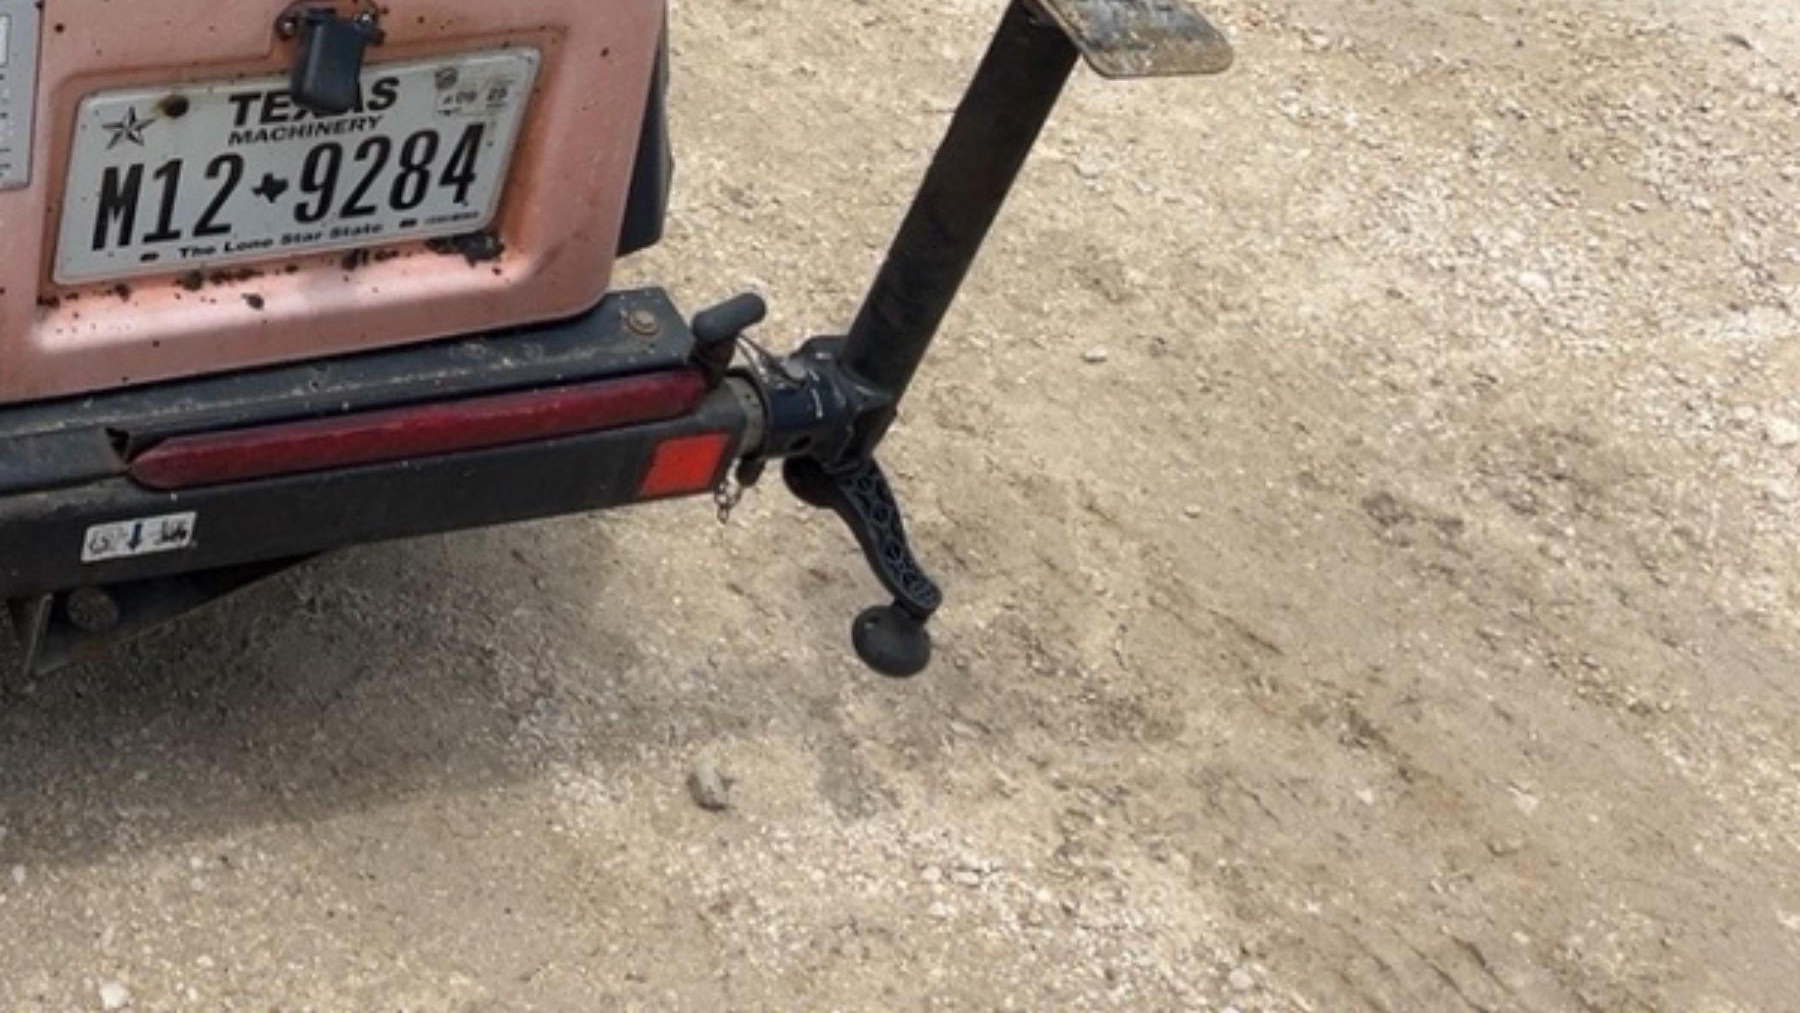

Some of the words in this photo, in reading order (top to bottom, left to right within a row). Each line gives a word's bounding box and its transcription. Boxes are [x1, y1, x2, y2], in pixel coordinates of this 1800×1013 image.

[229, 76, 400, 127] TES
[228, 115, 382, 146] MACHINERY
[179, 246, 216, 258] The
[224, 237, 273, 253] Lone
[282, 230, 322, 245] Star
[330, 222, 382, 238] State
